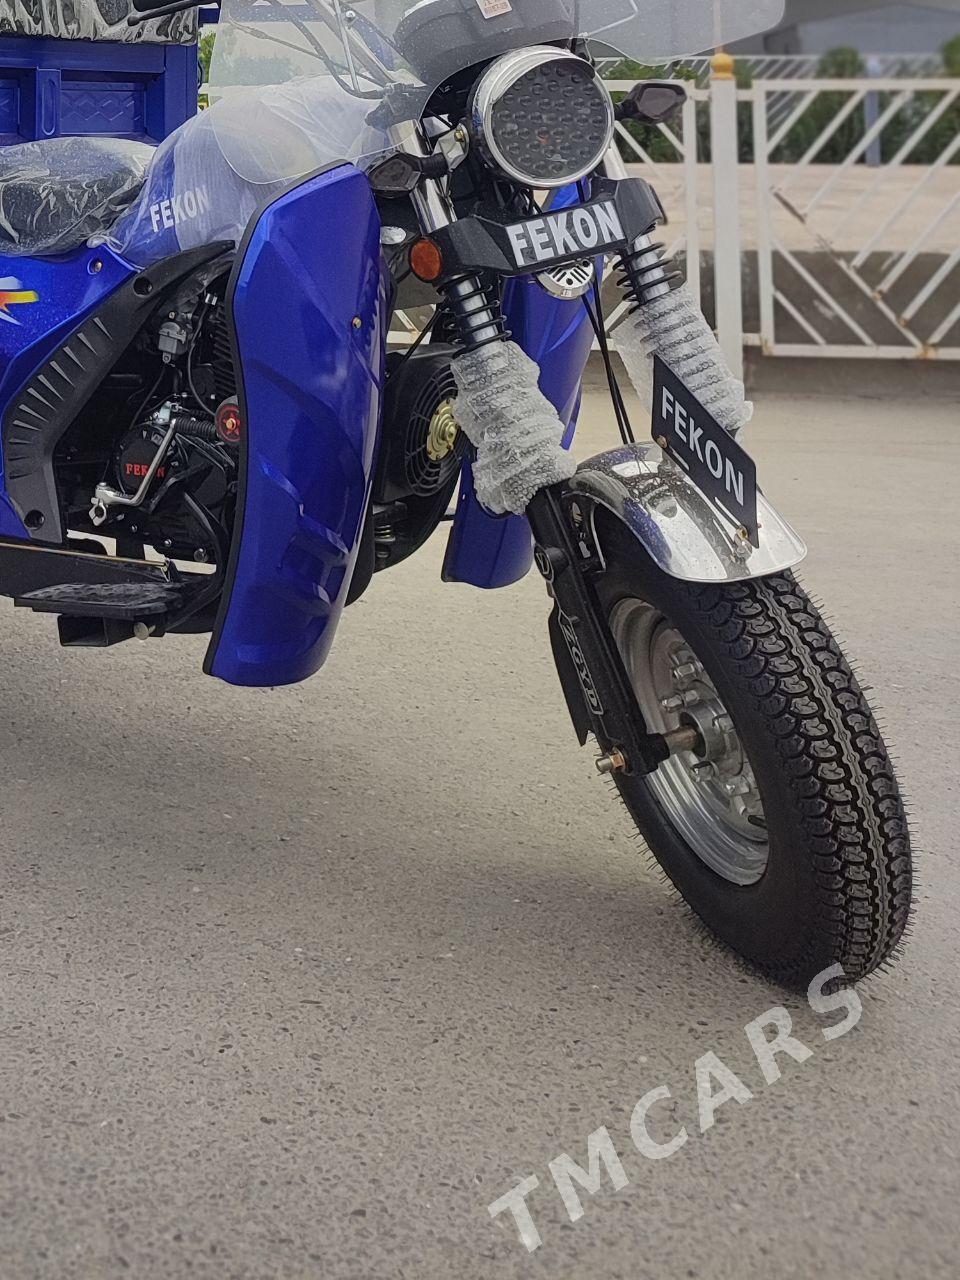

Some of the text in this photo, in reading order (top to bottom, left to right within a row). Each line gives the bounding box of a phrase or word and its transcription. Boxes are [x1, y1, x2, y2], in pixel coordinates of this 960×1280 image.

[149, 184, 209, 233] FEKON
[505, 200, 626, 268] FEKON
[125, 463, 166, 478] FEKN
[661, 385, 744, 507] FEKON
